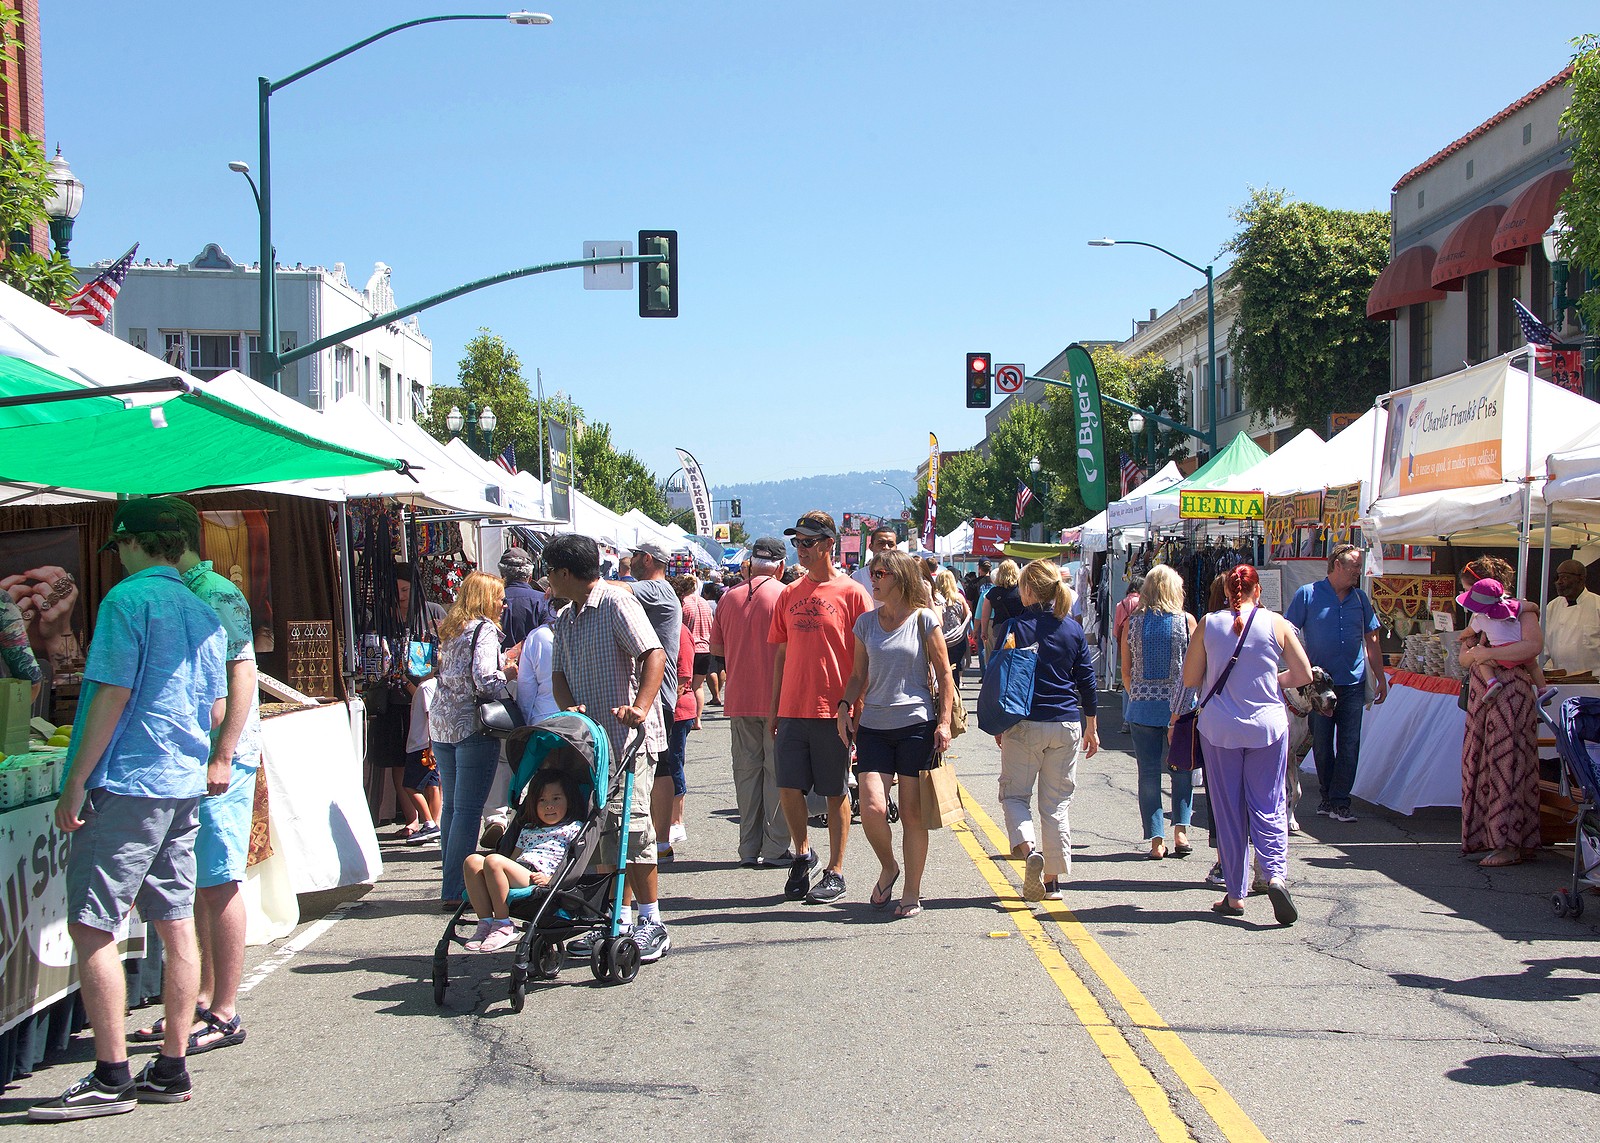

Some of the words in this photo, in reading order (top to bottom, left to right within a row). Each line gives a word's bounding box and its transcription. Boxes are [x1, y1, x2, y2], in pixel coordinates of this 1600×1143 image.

[1076, 374, 1098, 444] Byers
[1423, 408, 1449, 432] Charlie
[1449, 400, 1477, 426] Frank's
[1478, 396, 1497, 420] Pies
[1452, 454, 1467, 469] makes
[1467, 456, 1477, 472] you
[685, 467, 710, 535] WALKABOUT
[1181, 496, 1264, 515] HENNA
[976, 521, 993, 530] More
[995, 523, 1010, 532] This
[790, 597, 809, 613] STAY
[811, 596, 838, 615] SALTY
